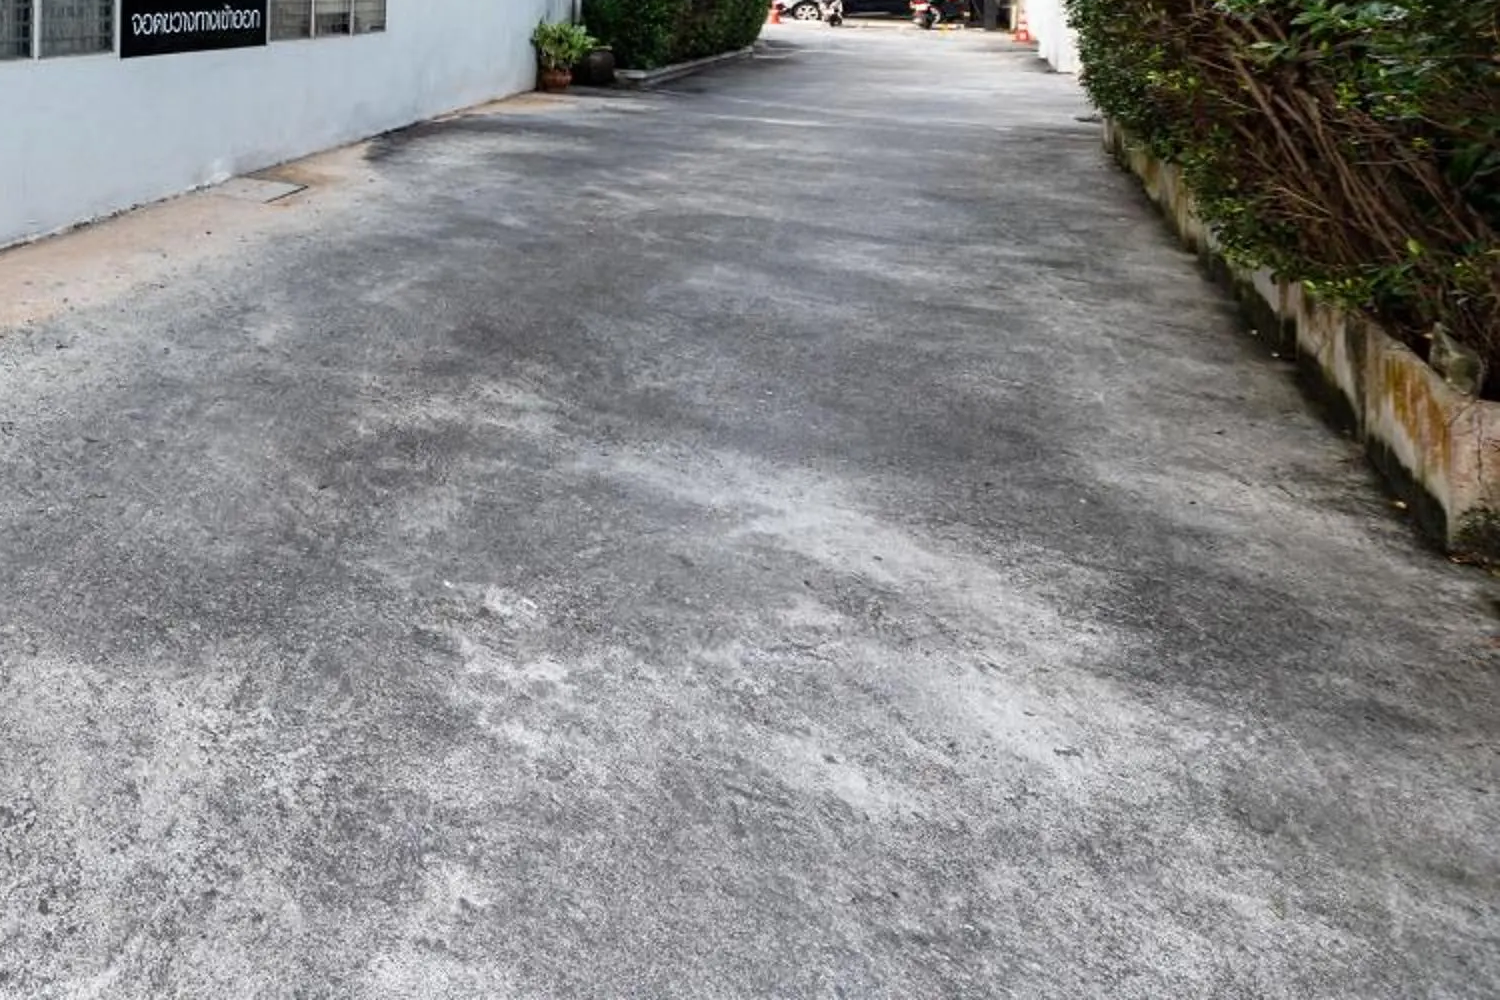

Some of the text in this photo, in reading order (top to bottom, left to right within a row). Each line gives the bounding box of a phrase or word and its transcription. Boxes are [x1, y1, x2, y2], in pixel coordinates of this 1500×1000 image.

[131, 2, 260, 37] จอดขวางทางเข้าออก
